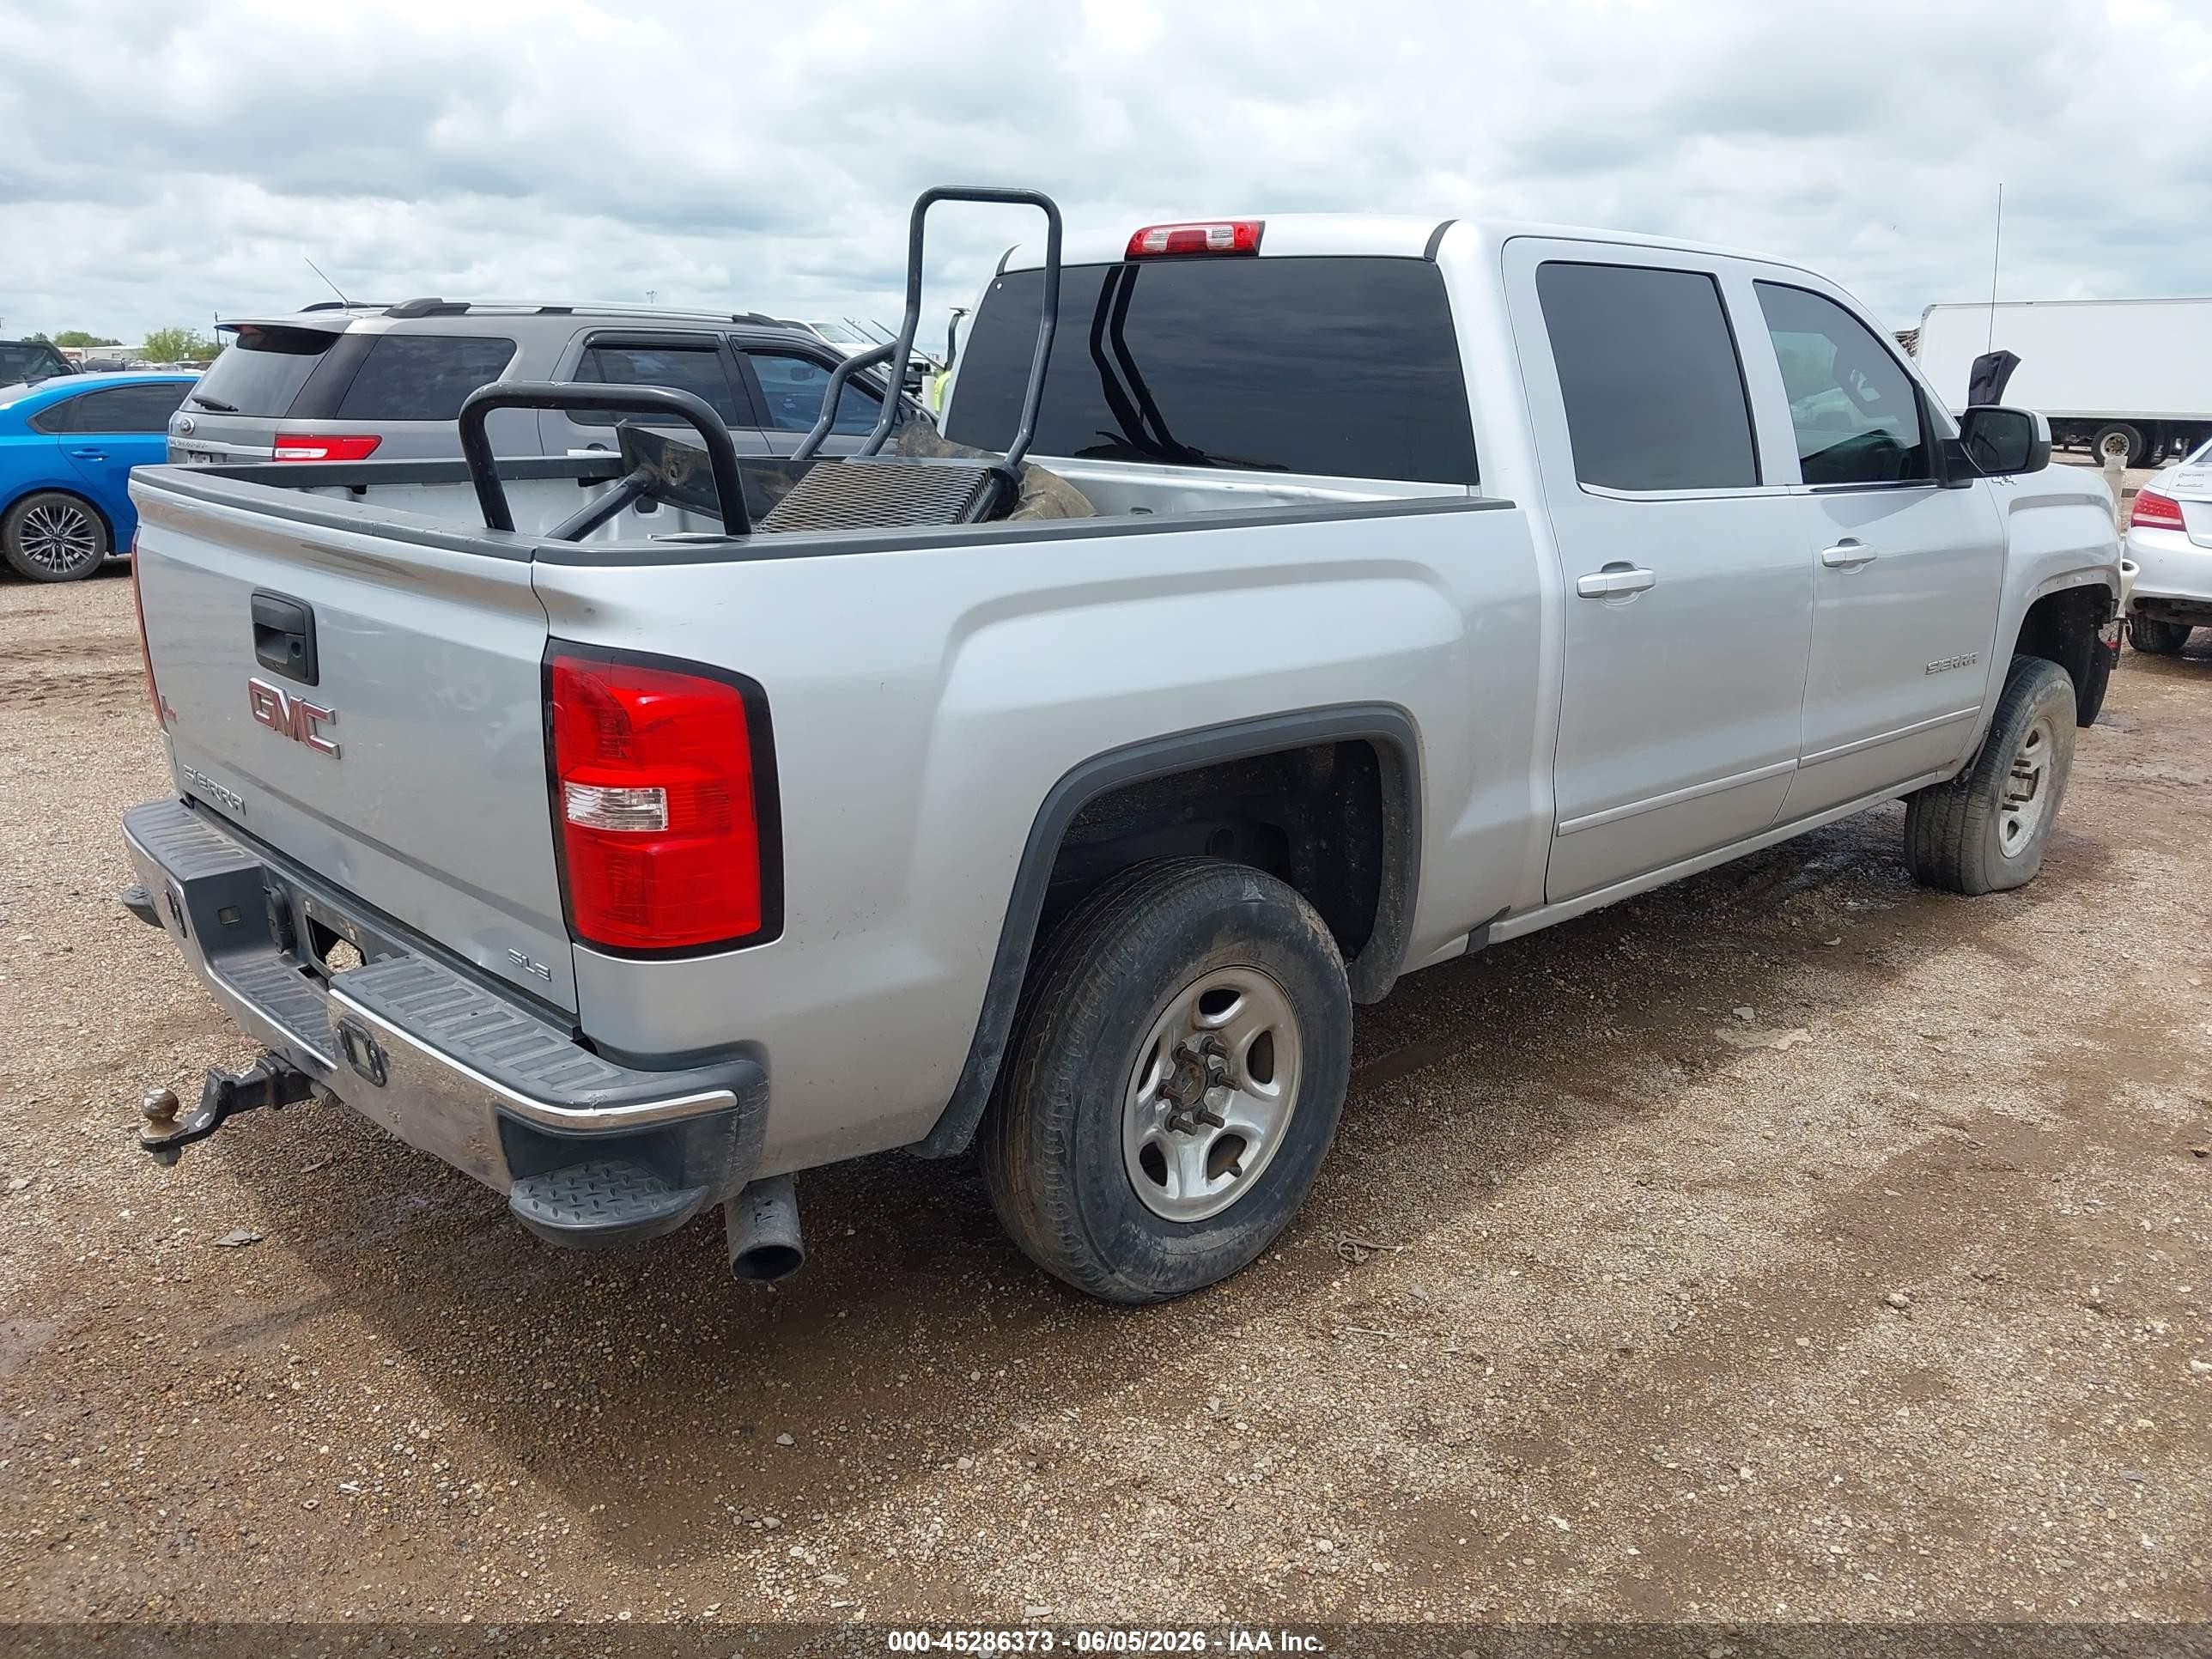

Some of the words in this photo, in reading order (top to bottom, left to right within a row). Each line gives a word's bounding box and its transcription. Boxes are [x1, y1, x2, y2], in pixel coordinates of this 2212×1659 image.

[1925, 651, 1979, 676] SIERRA
[248, 677, 342, 760] GMC
[183, 763, 246, 817] SIERRA
[507, 948, 552, 983] SLE
